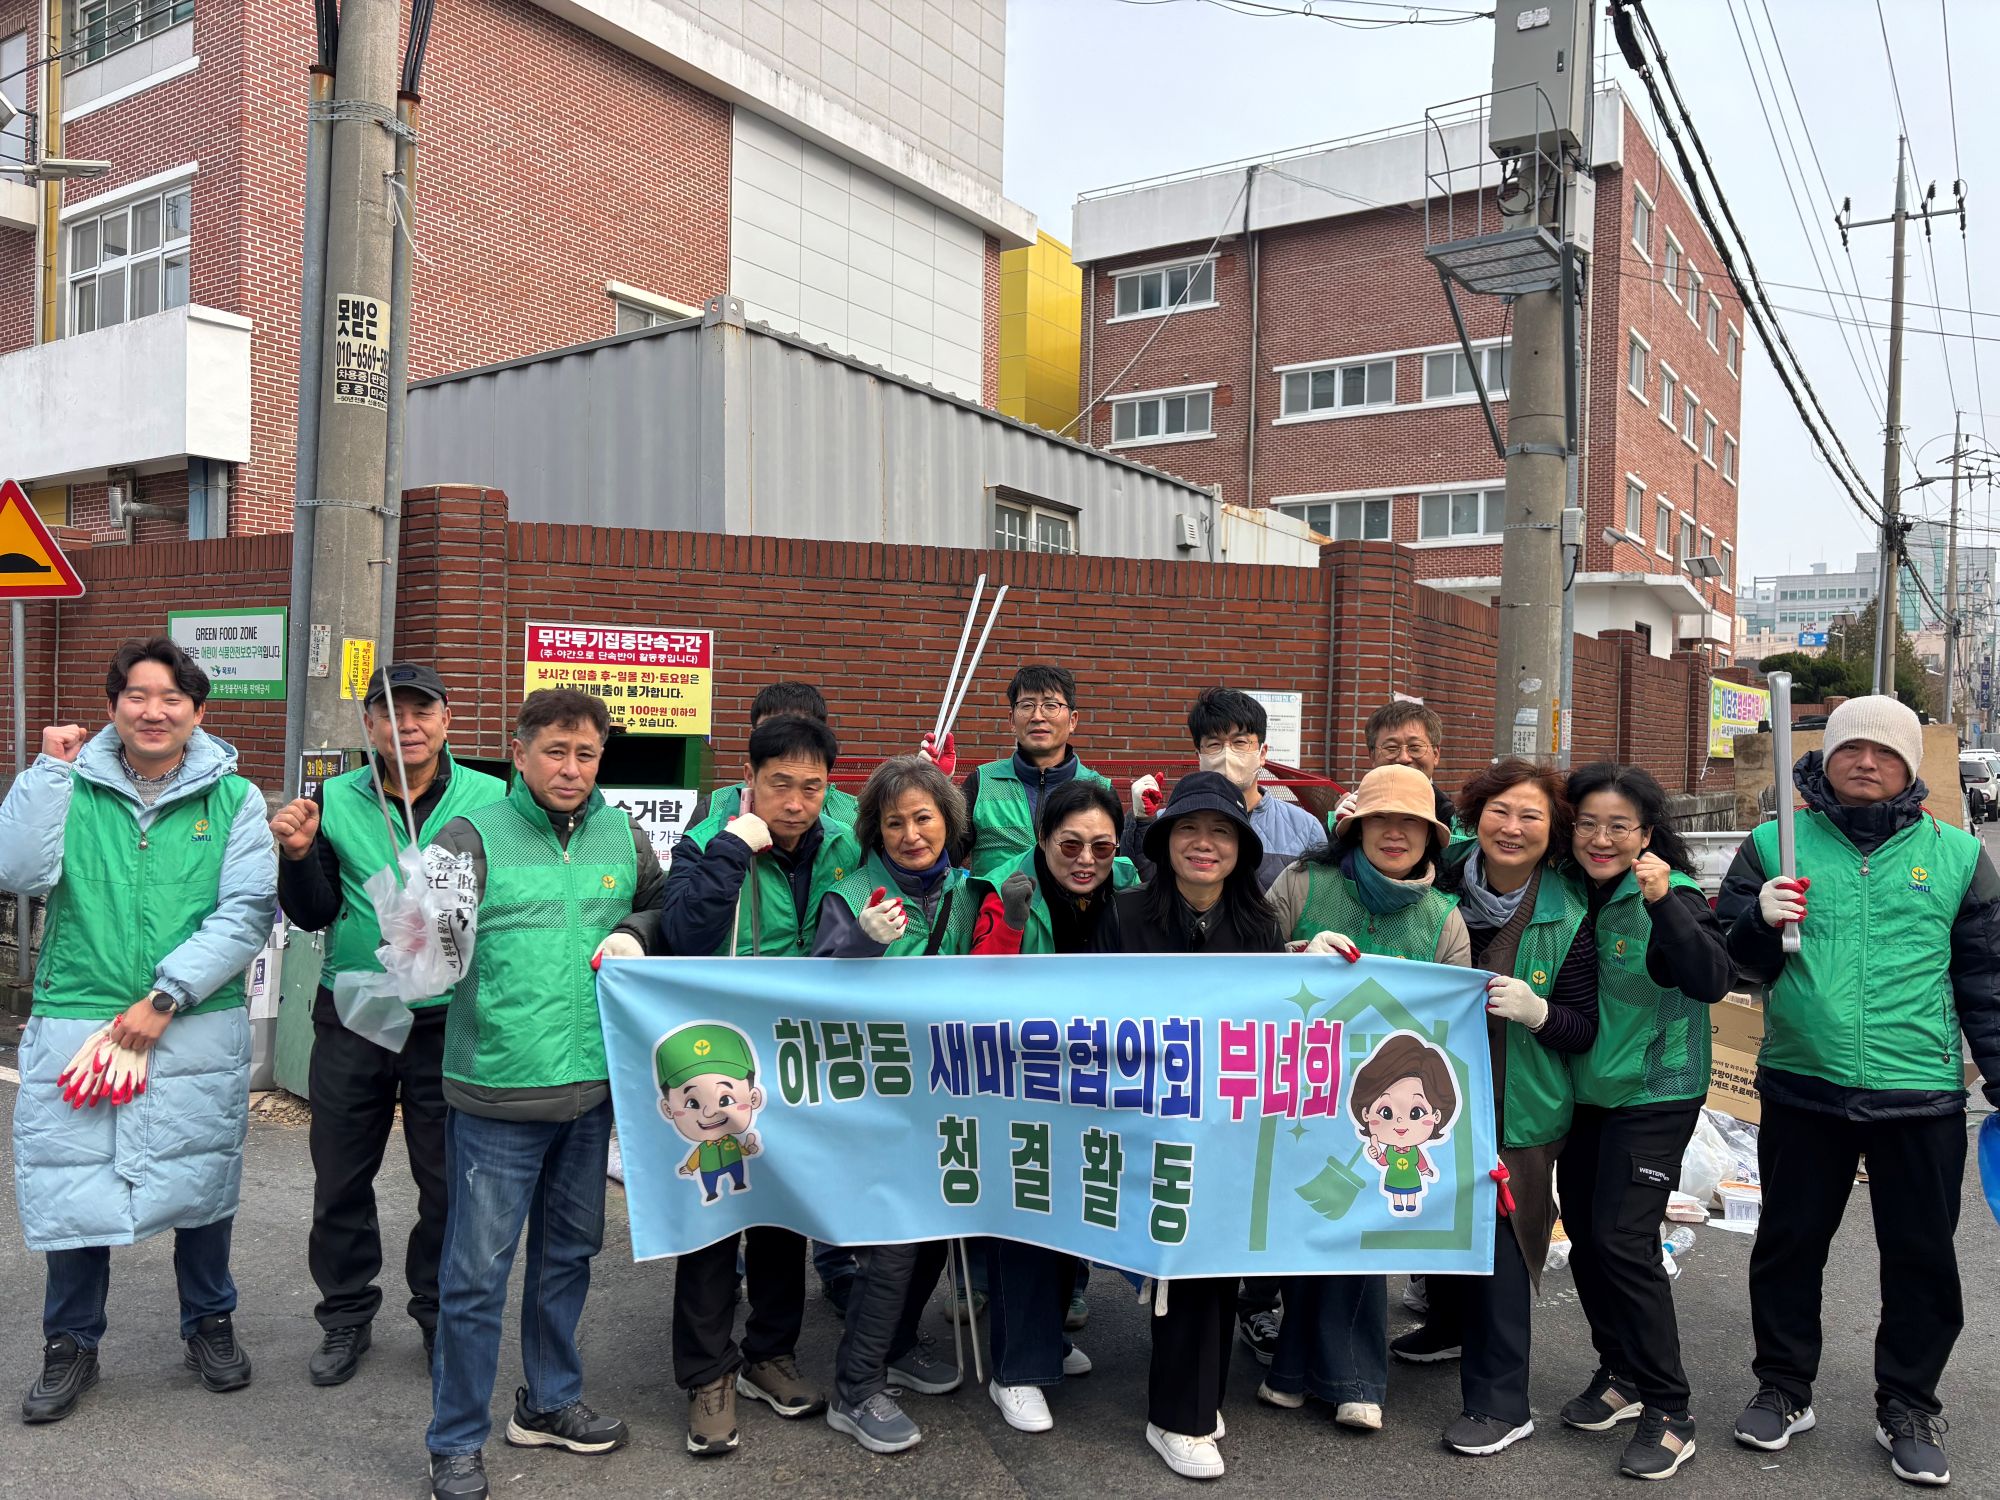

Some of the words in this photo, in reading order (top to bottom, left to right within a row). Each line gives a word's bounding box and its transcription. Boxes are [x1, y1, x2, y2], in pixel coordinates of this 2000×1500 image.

[337, 299, 378, 341] 못받은
[338, 369, 368, 383] 차용증
[195, 627, 217, 641] GREEN
[219, 626, 238, 640] FOOD
[240, 626, 258, 640] ZONE
[538, 629, 702, 653] 무단투기집중단속구간
[201, 646, 218, 659] 어린이
[598, 651, 636, 662] 단속반이
[639, 653, 698, 665] 활동중입니다)
[538, 668, 569, 680] 낮시간
[572, 669, 598, 681] (일출
[600, 670, 638, 683] 후~일몰
[626, 685, 684, 699] 불가합니다.
[629, 705, 668, 716] 100만원
[670, 706, 697, 717] 이하의
[627, 718, 636, 727] 수
[639, 718, 677, 728] 있습니다.
[774, 1017, 913, 1105] 하당동
[929, 1017, 1202, 1120] 새마을협의회
[1219, 1019, 1344, 1121] 부녀회
[1711, 1079, 1730, 1091] 게뜨
